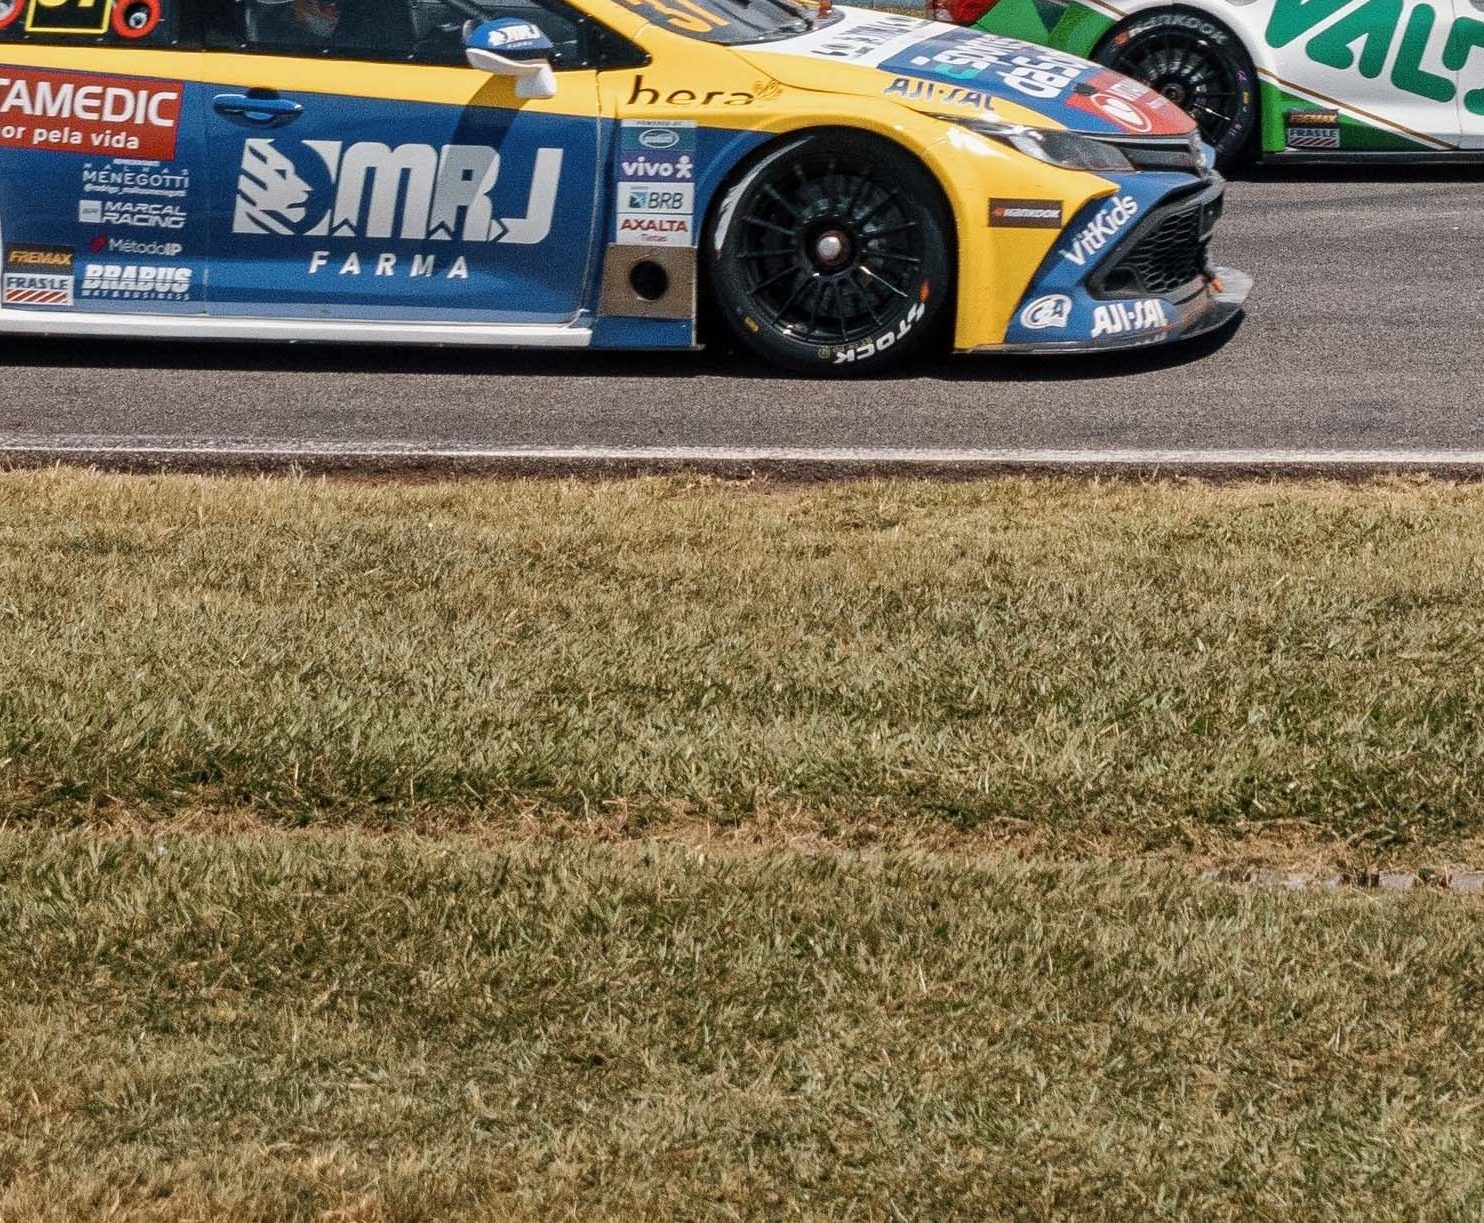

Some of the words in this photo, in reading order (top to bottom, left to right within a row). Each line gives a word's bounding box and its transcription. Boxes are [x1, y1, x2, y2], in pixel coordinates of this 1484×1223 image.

[627, 75, 755, 106] hera
[32, 126, 83, 146] pela
[90, 130, 140, 150] vida
[82, 170, 190, 188] MENEGOTTI
[622, 156, 673, 178] vivo
[305, 140, 563, 246] MRJ
[647, 191, 684, 210] BRB
[102, 213, 187, 229] RACING
[620, 218, 688, 233] AXALTA
[1060, 194, 1140, 266] VitKids
[9, 250, 73, 266] FREMAX
[309, 251, 469, 280] FARMA
[81, 264, 193, 293] BRABUS
[832, 302, 926, 365] STOCK
